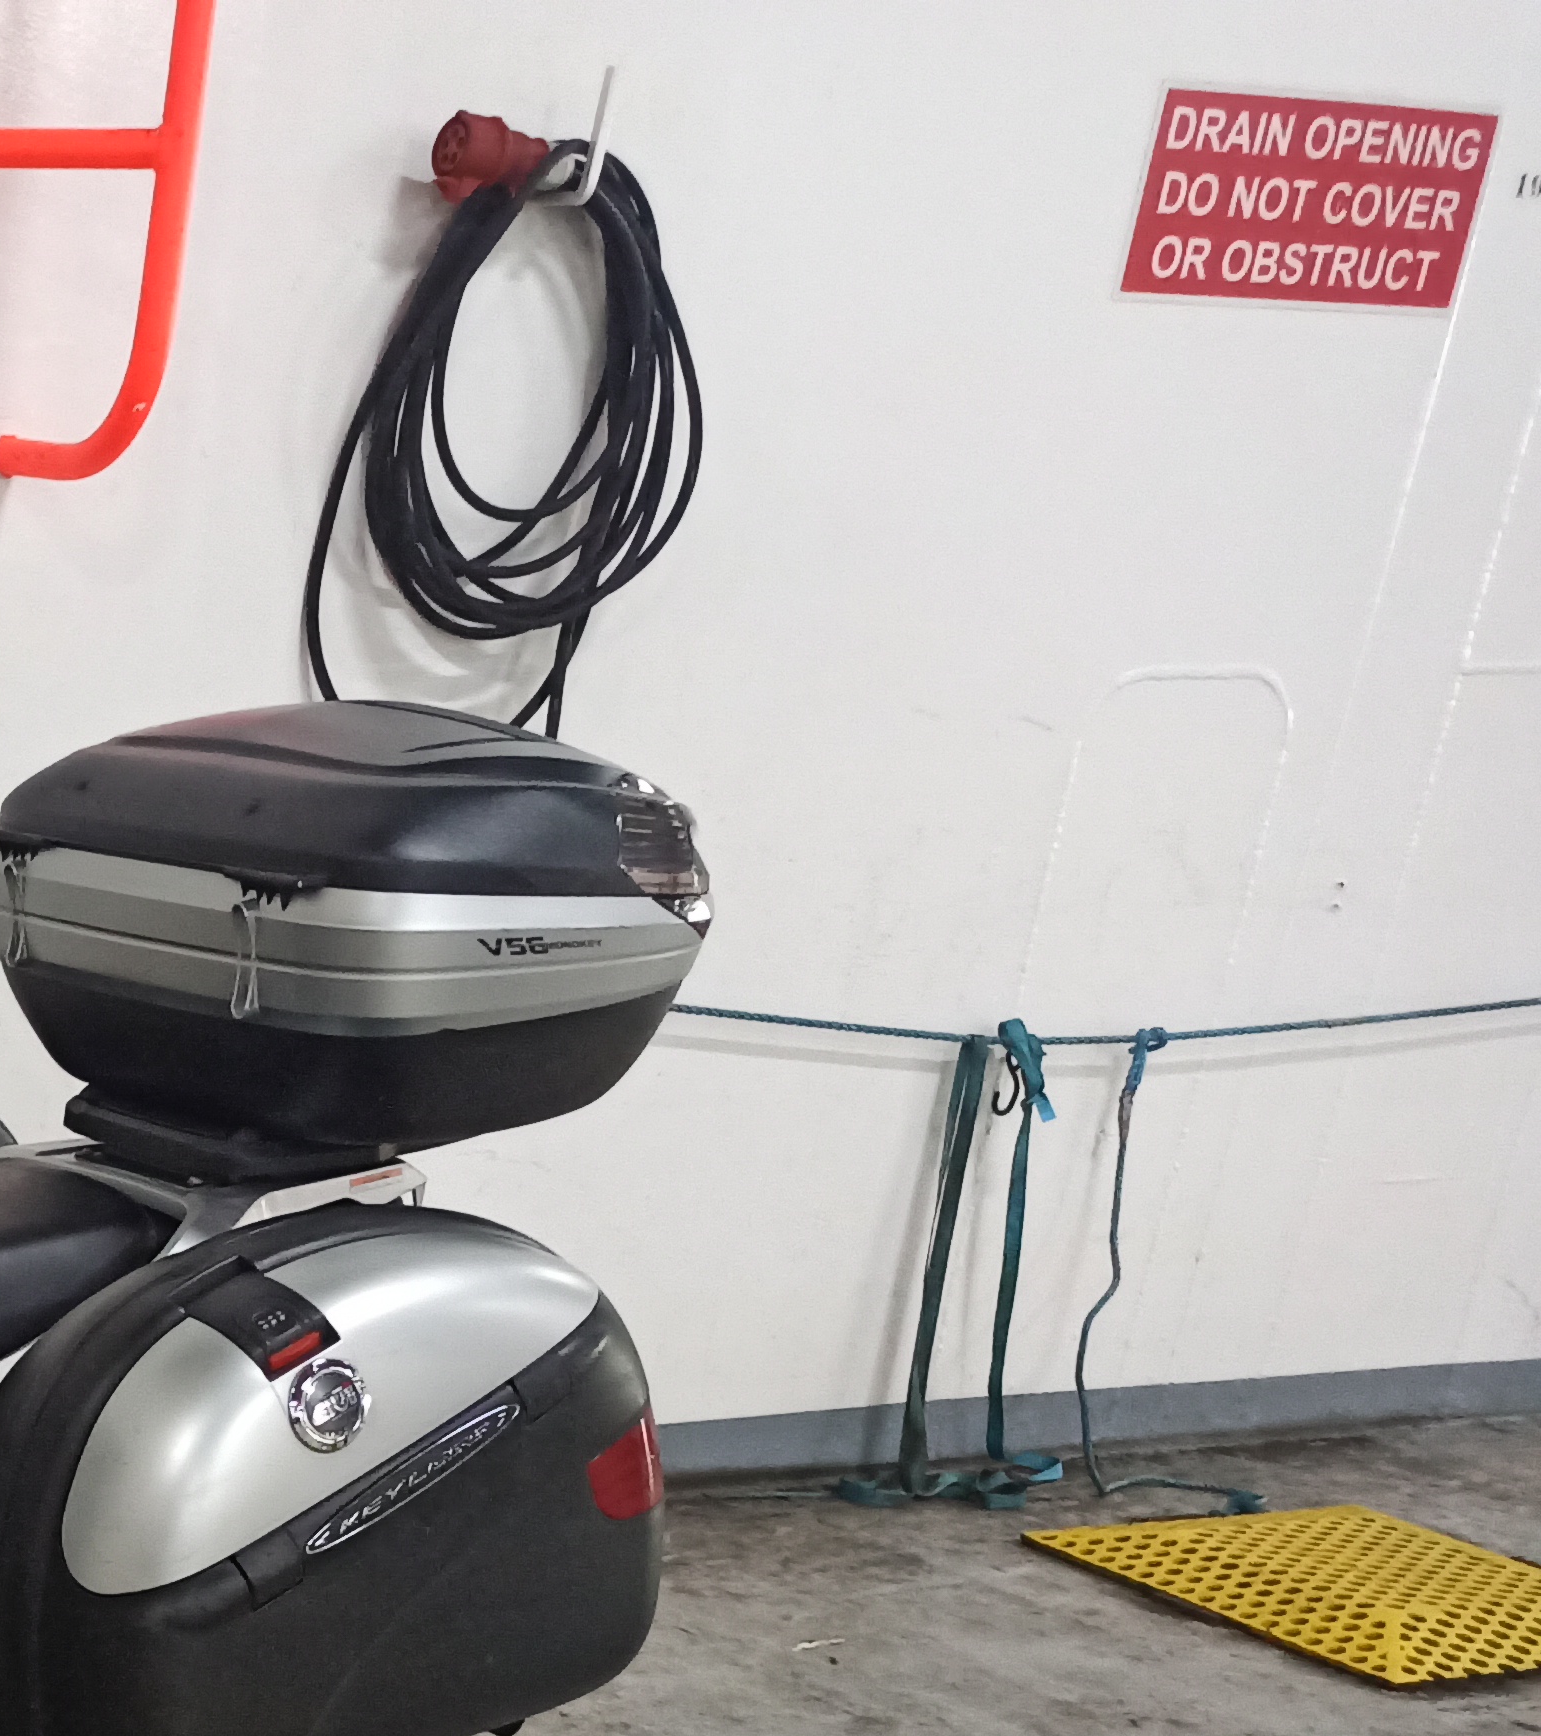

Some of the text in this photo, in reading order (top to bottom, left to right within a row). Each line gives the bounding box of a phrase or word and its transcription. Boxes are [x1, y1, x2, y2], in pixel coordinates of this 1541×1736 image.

[1166, 106, 1481, 171] DRAIN OPENING
[1157, 171, 1460, 231] DO NOT COVER
[1151, 235, 1439, 292] OR OBSTRUCT
